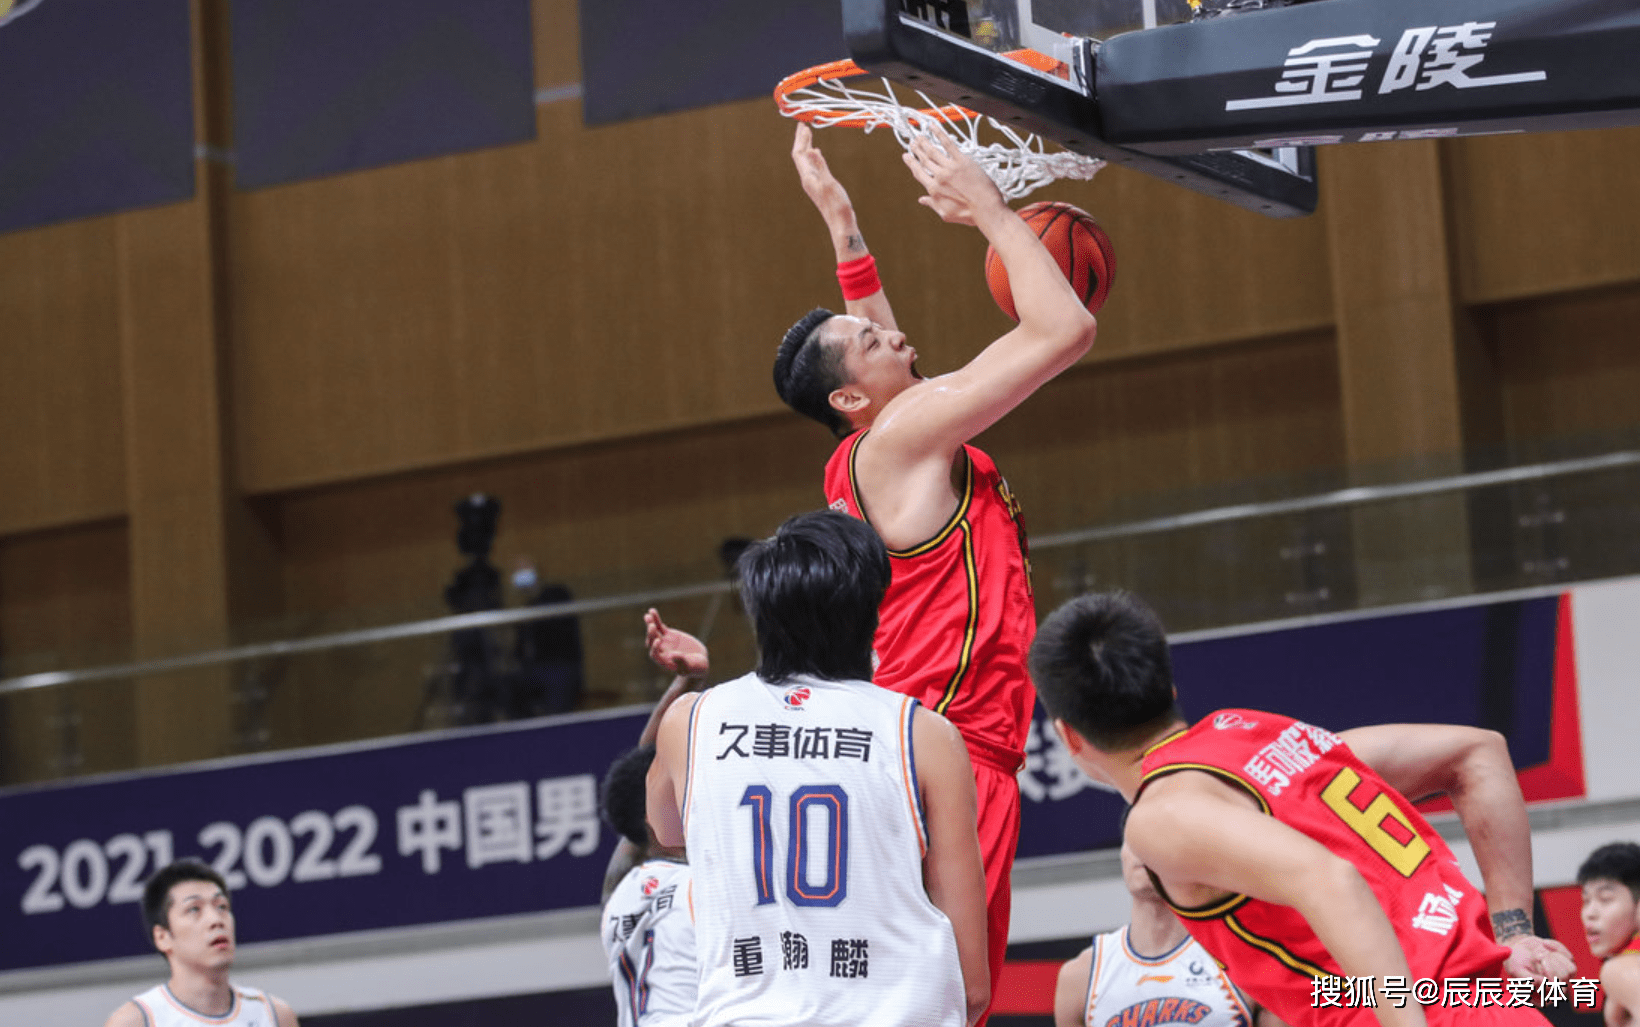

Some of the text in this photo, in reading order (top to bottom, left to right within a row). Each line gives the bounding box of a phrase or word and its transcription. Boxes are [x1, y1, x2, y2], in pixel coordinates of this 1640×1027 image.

[1225, 21, 1546, 111] 金陵
[715, 722, 873, 762] 久事体育
[396, 773, 601, 875] 中国男
[739, 784, 849, 908] 10
[1319, 766, 1431, 878] 6
[610, 884, 678, 943] 久事育
